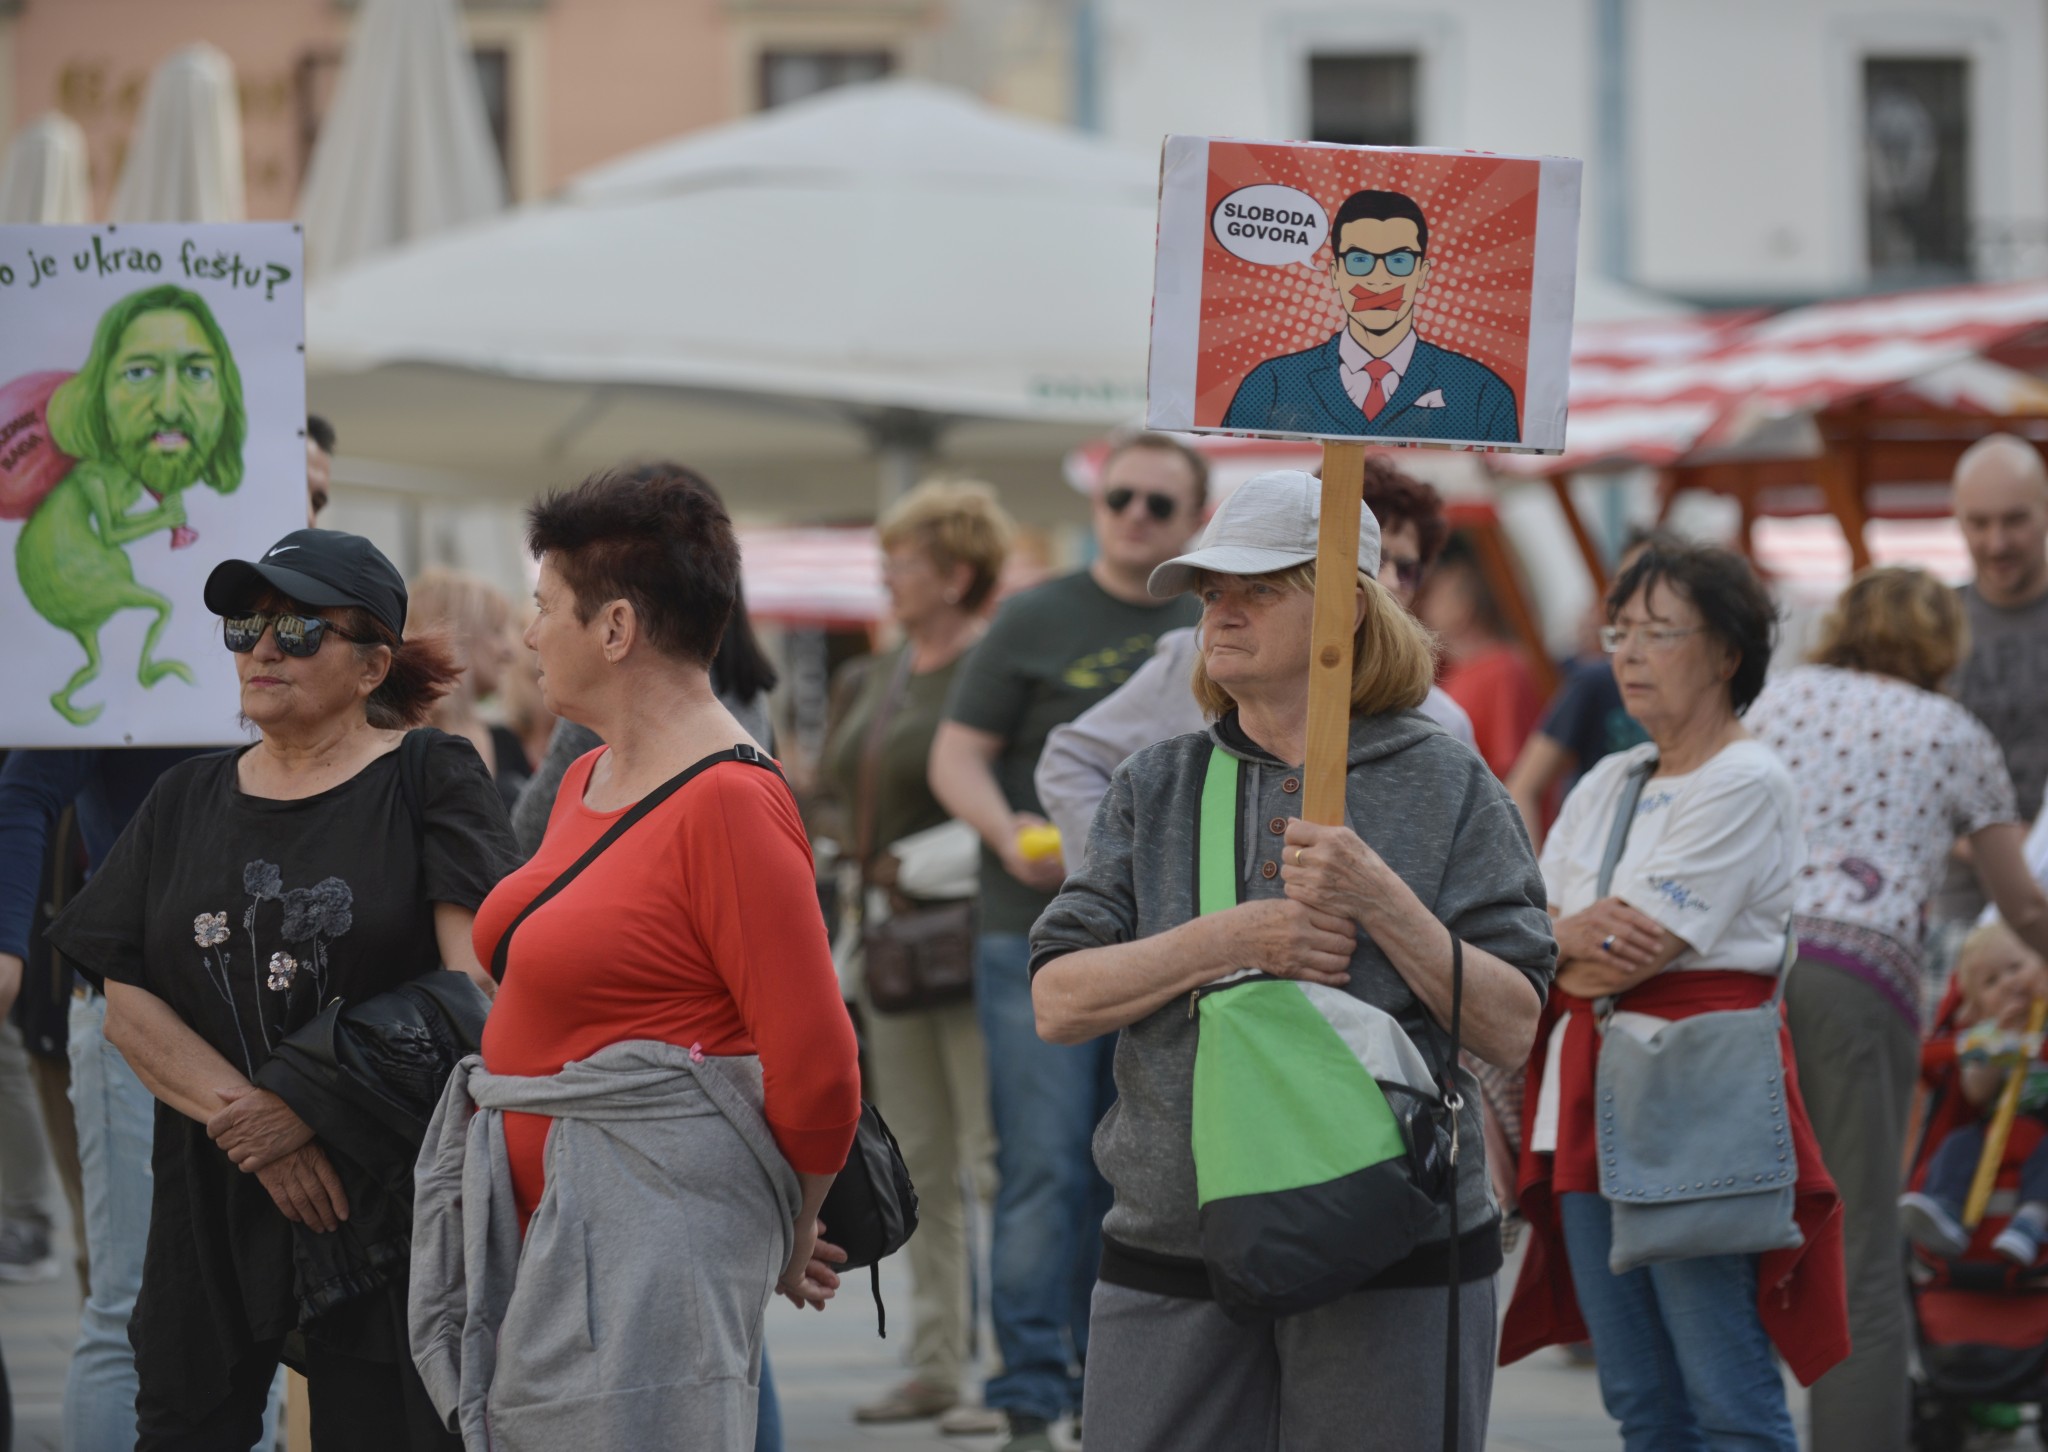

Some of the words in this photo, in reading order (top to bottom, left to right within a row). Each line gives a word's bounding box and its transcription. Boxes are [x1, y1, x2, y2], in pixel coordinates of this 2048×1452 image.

[1224, 202, 1316, 228] SLOBODA
[1227, 221, 1309, 246] GOVORA
[0, 264, 15, 286] o
[28, 249, 56, 288] je
[73, 235, 162, 277] ukrao
[181, 238, 292, 301] feštu?
